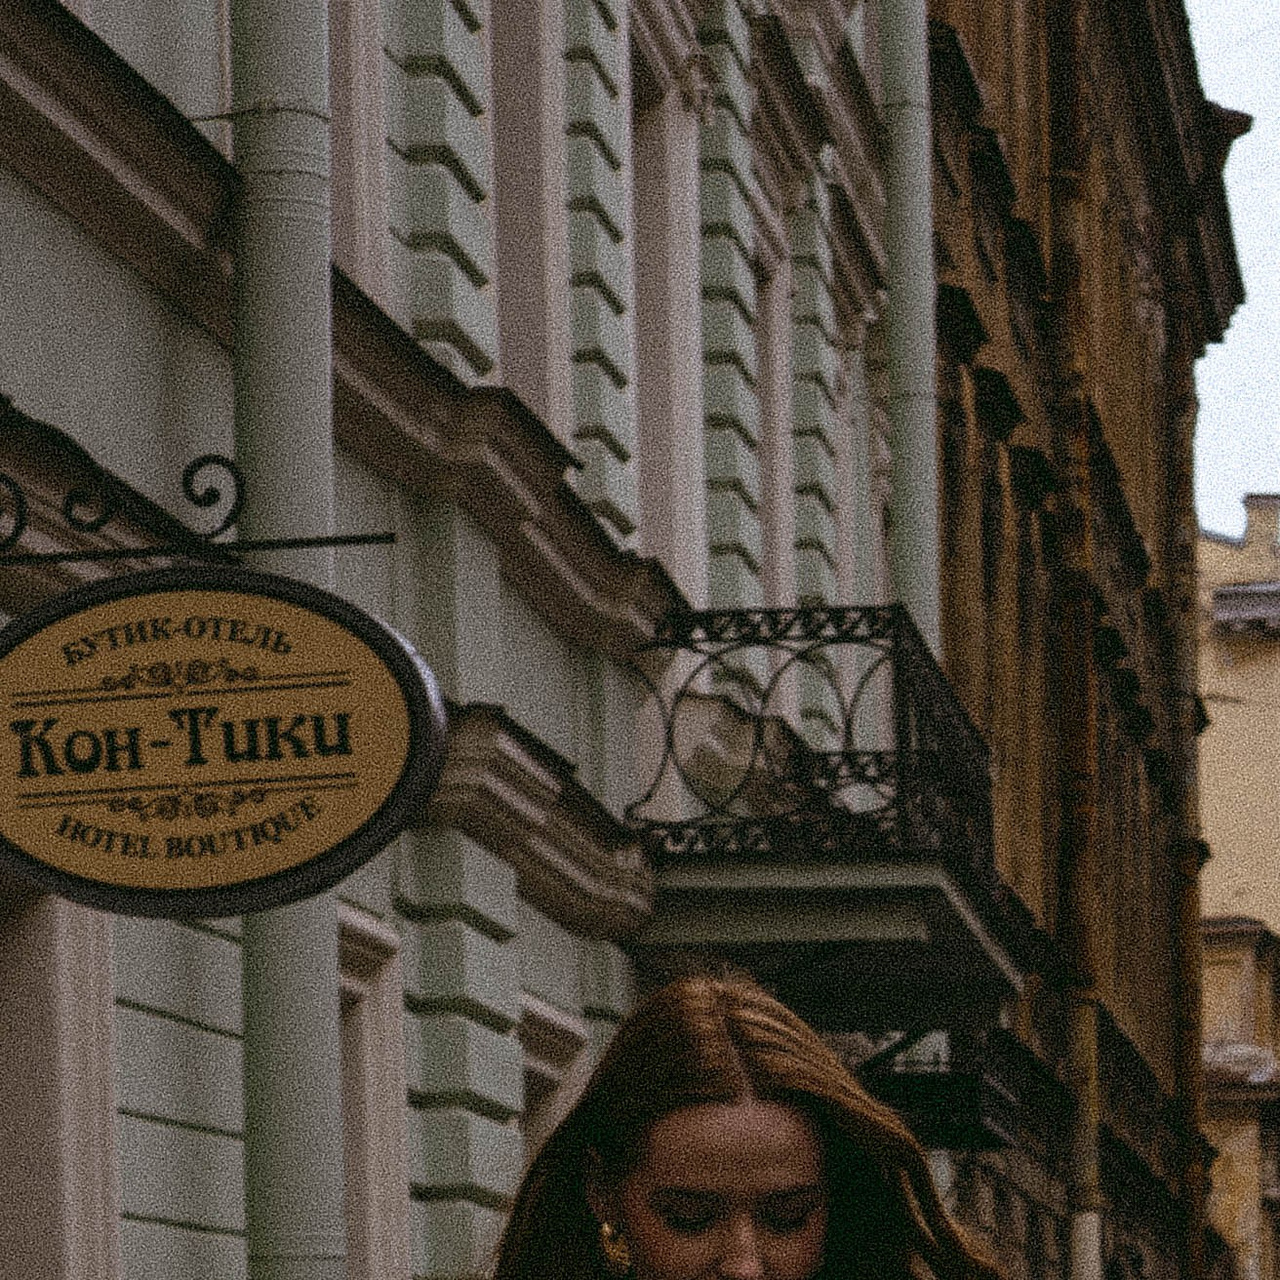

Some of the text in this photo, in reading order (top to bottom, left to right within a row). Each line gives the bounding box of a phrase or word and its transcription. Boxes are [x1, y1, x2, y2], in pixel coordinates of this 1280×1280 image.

[61, 615, 293, 666] БУТИК-ОТЕЛЬ
[9, 706, 352, 779] Кон-Тики
[55, 795, 322, 860] HOTEL BOUTIQUE
